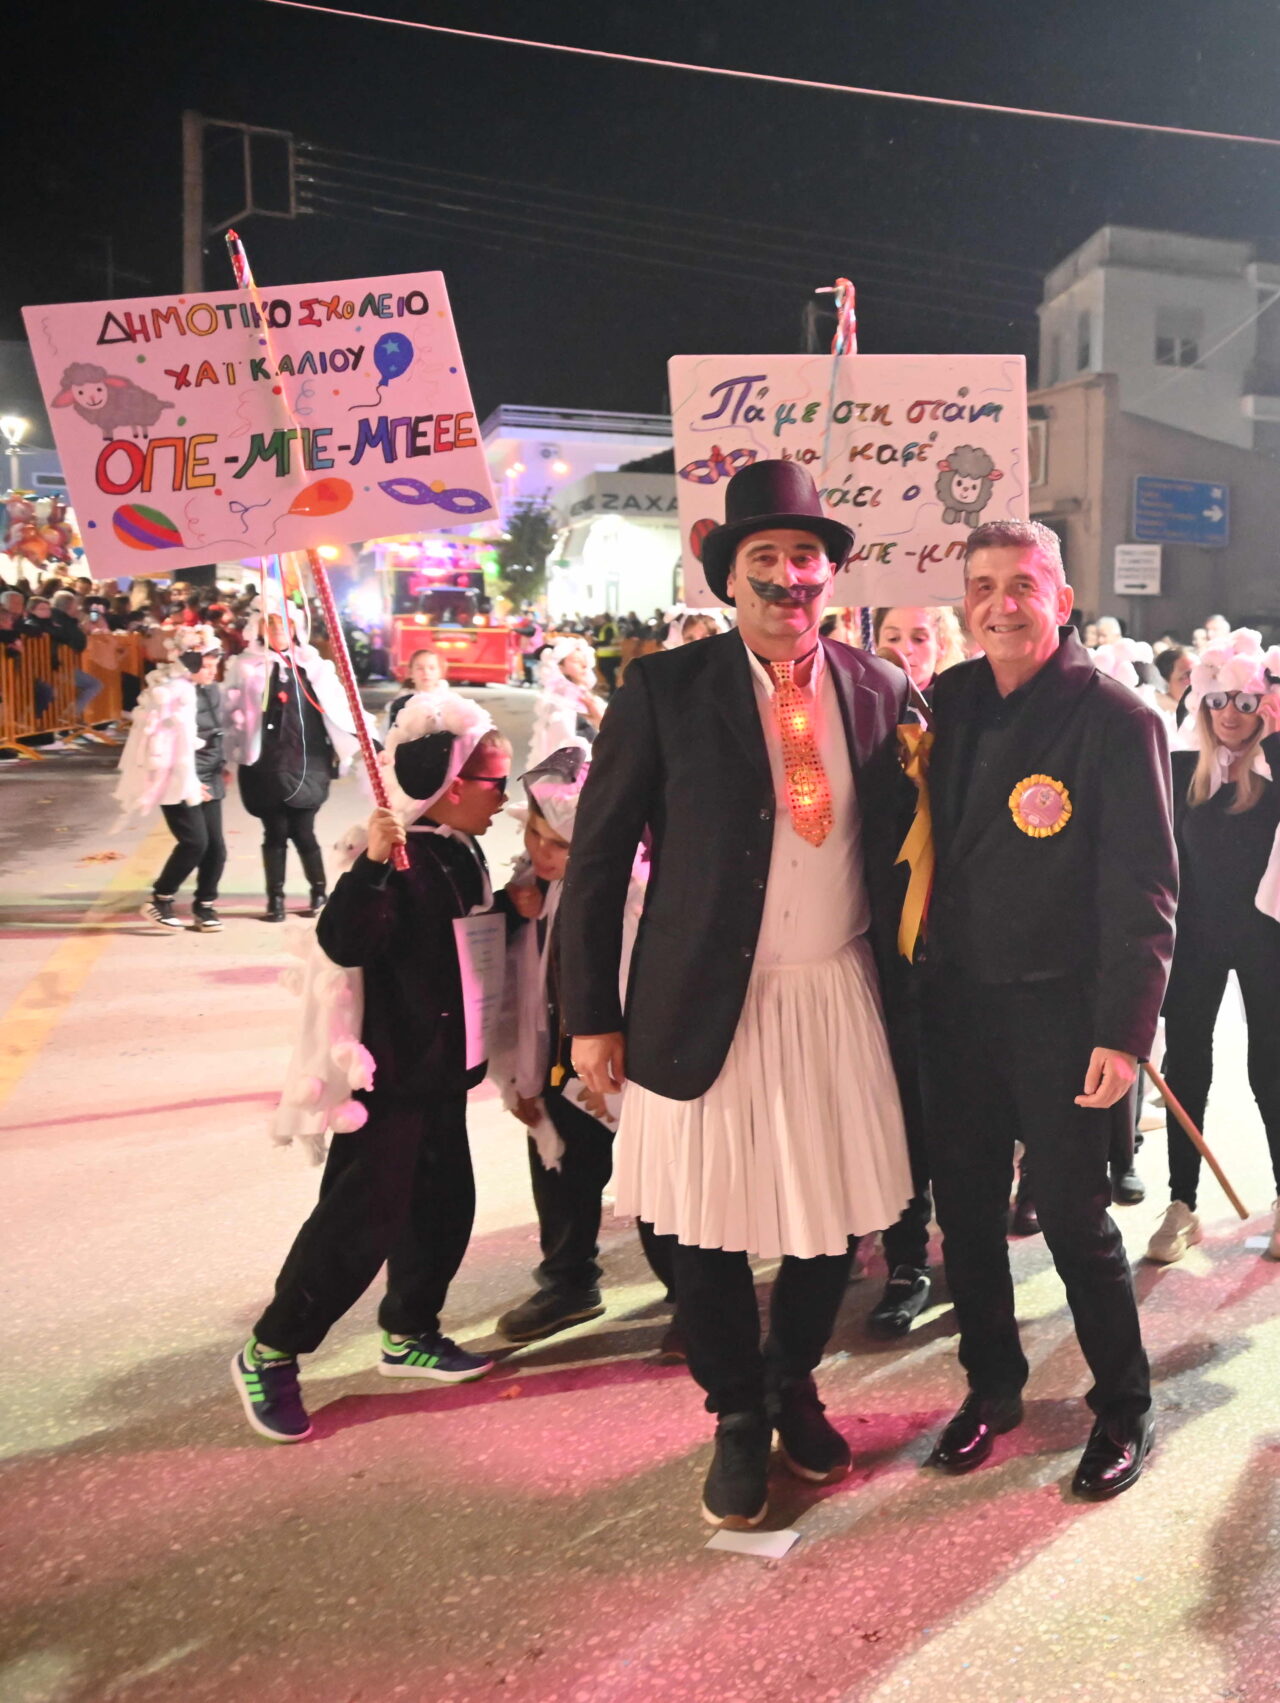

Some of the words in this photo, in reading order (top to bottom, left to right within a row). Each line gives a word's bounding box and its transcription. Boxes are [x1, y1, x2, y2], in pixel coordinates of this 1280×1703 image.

[97, 299, 292, 345] ΔΗΜΟΤΙΚΟ
[298, 290, 430, 328] ΣΧΟΛΕΙΟ
[833, 400, 893, 427] στη
[848, 431, 938, 468] καφέ
